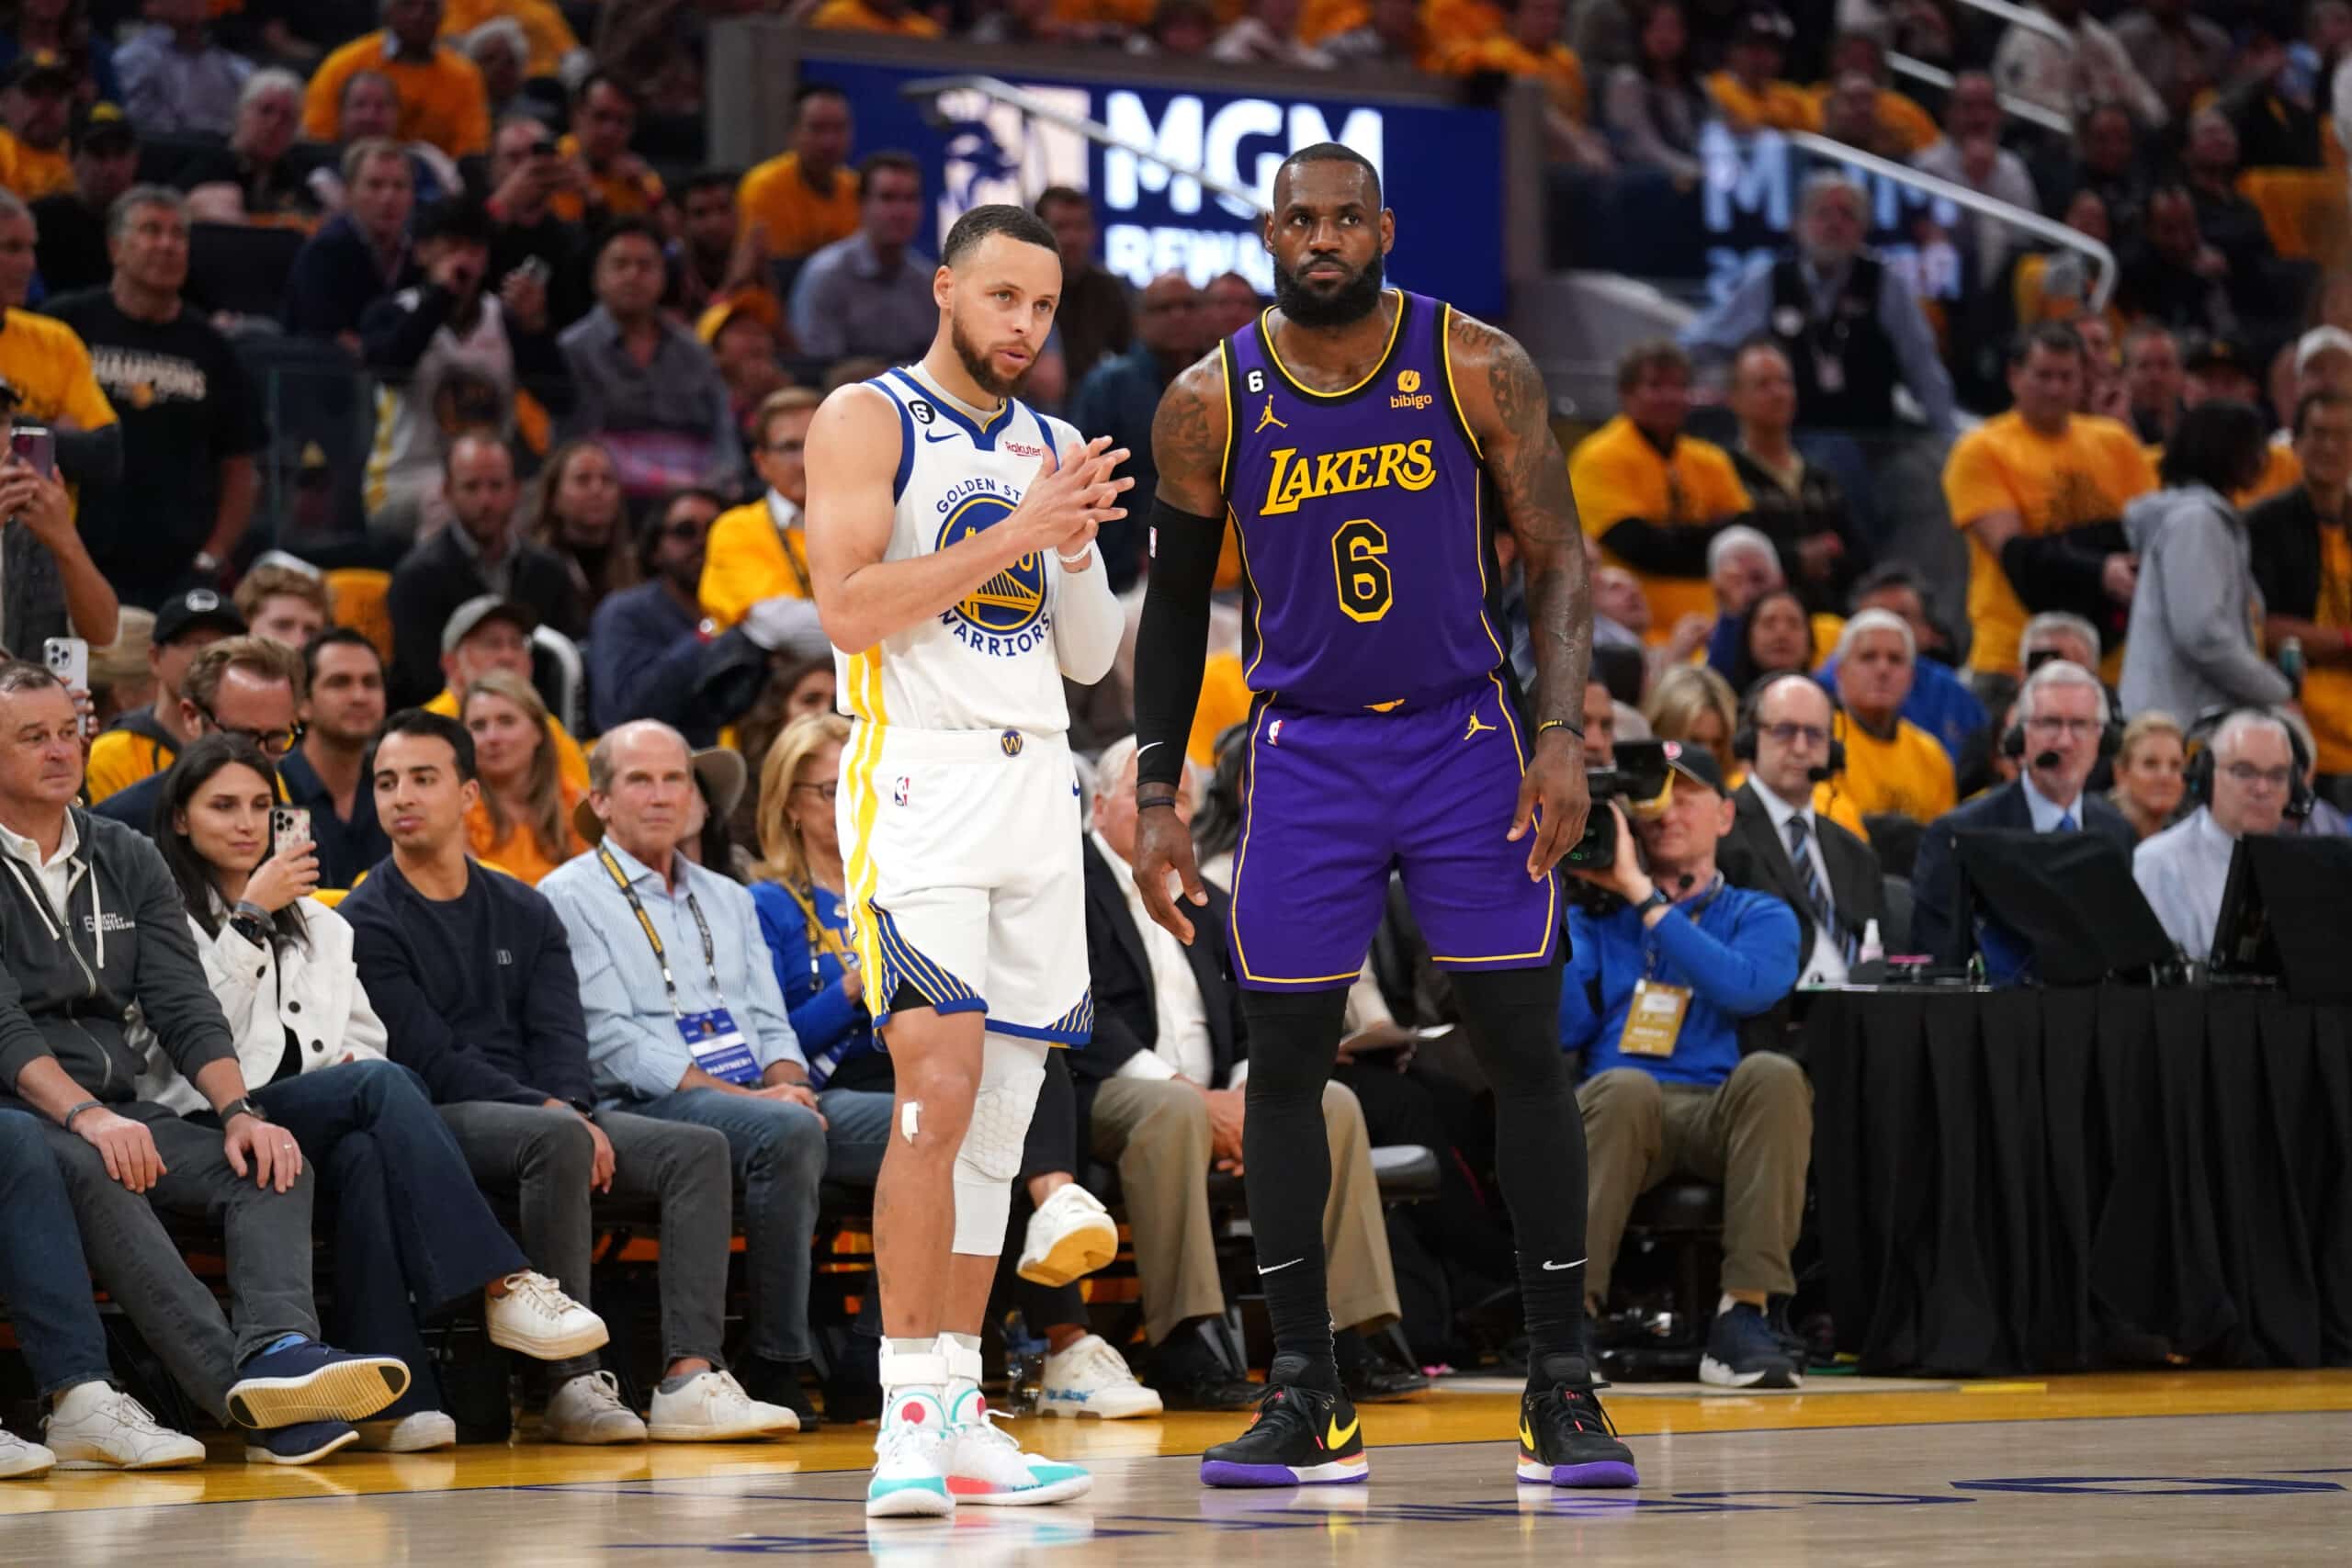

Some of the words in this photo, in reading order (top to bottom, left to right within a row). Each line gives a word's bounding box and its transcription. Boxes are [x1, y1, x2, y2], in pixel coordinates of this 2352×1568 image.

[1248, 370, 1264, 393] 6
[912, 403, 931, 423] 6
[1390, 392, 1432, 410] bibigo
[1259, 438, 1437, 516] LAKERS
[936, 477, 996, 513] GOLDEN
[1331, 518, 1393, 624] 6
[938, 609, 1050, 658] WARRIORS
[1002, 735, 1022, 753] W
